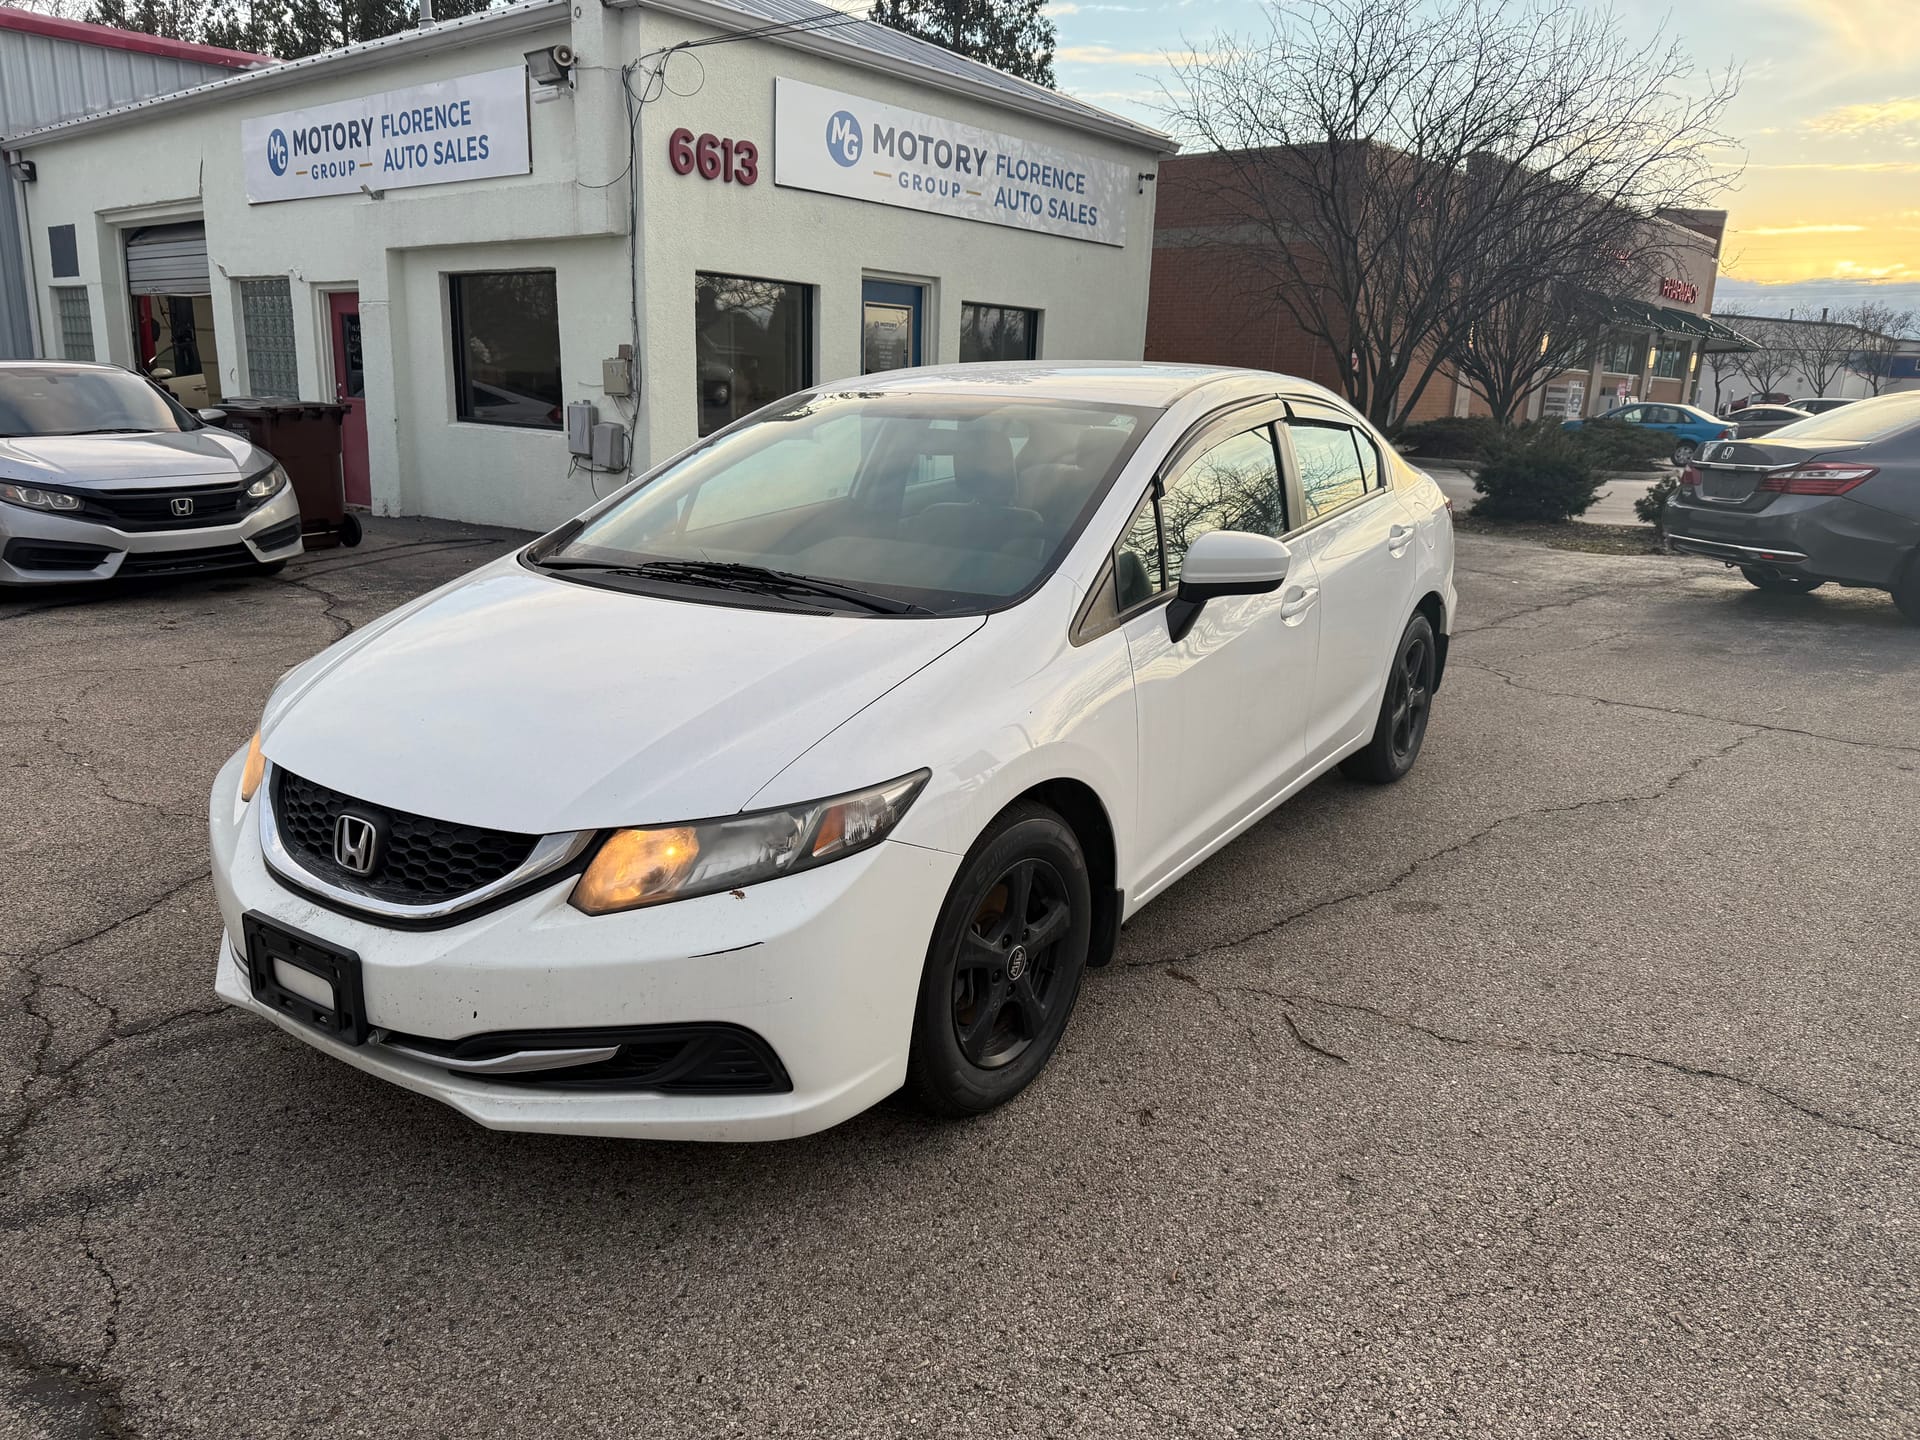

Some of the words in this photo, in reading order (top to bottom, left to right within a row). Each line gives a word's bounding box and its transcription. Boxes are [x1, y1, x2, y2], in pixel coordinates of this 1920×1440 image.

[293, 117, 374, 157] MOTORY
[381, 100, 472, 138] FLORENCE
[311, 159, 356, 180] GROUP
[383, 143, 428, 172] AUTO
[433, 134, 489, 166] SALES
[669, 127, 758, 186] 6613
[873, 123, 988, 178] MOTORY
[898, 172, 961, 199] GROUP
[995, 153, 1086, 196] FLORENCE
[994, 188, 1043, 217] AUTO
[1047, 200, 1098, 227] SALES
[1663, 277, 1699, 304] PHARMACY
